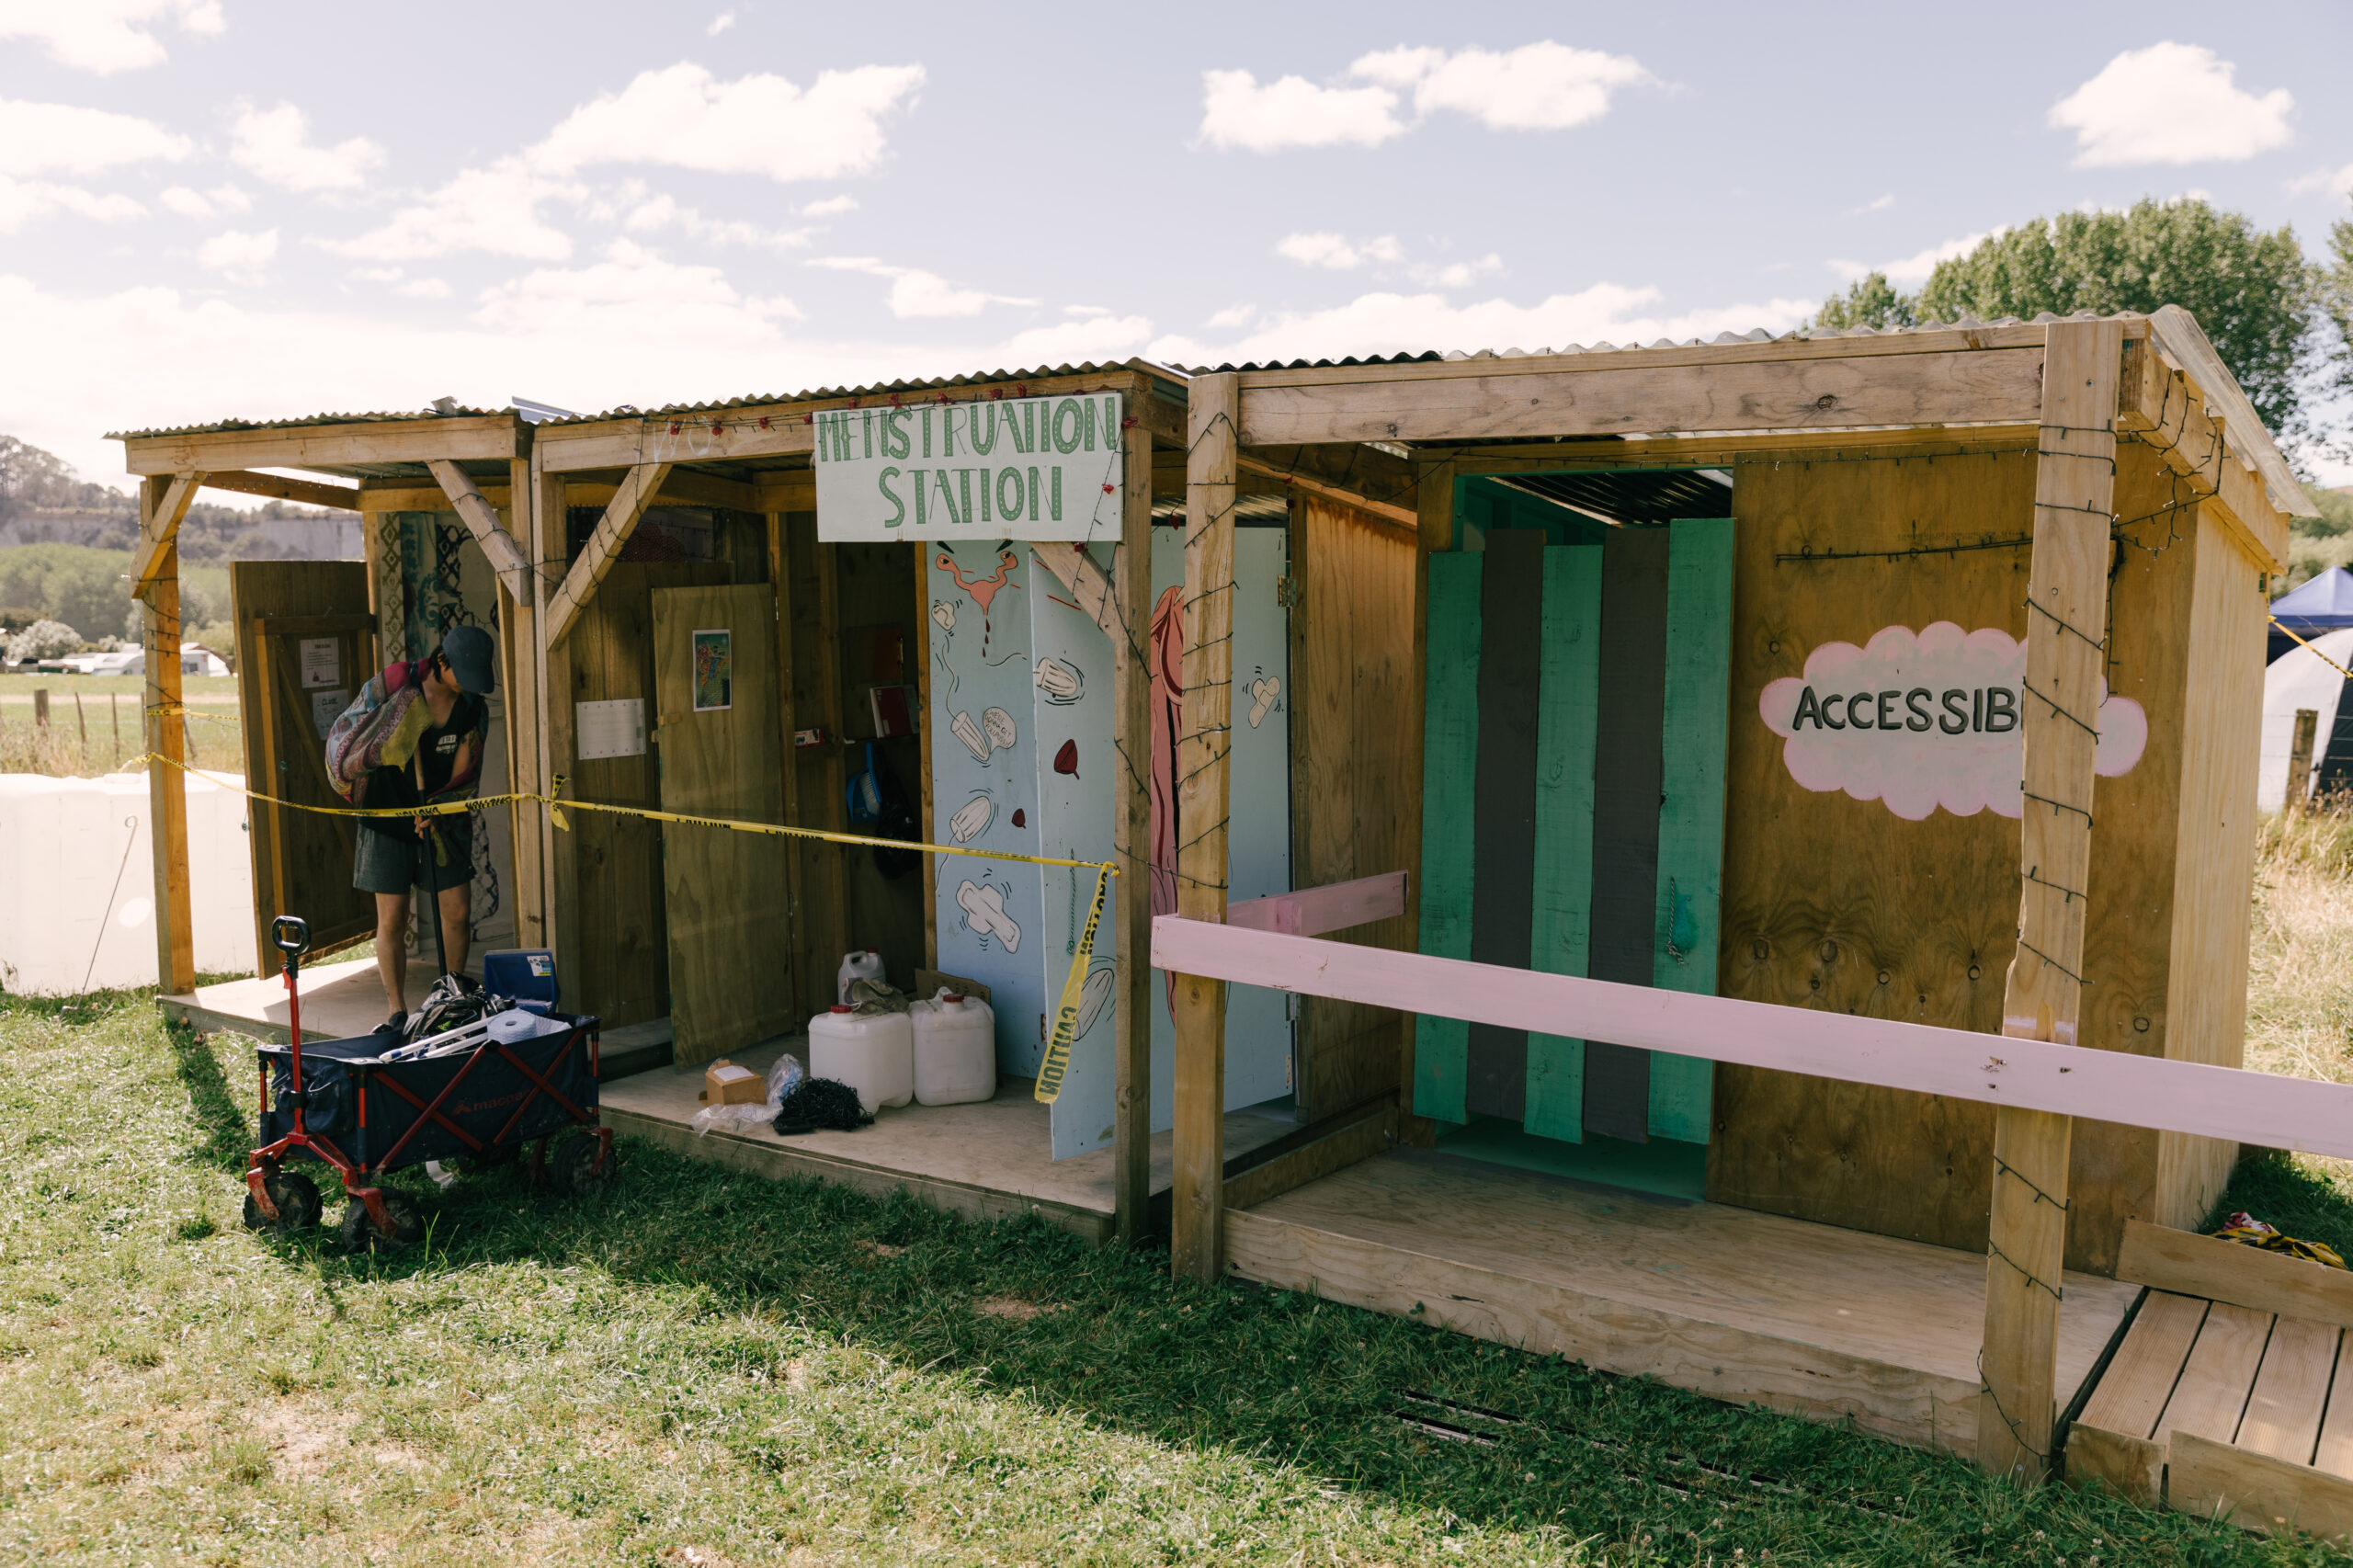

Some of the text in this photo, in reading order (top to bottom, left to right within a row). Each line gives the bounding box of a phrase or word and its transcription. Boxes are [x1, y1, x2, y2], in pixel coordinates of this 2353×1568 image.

[817, 397, 1117, 462] MENSTRUATION
[879, 466, 1063, 528] STATION
[1792, 686, 2024, 734] ACCESSIB
